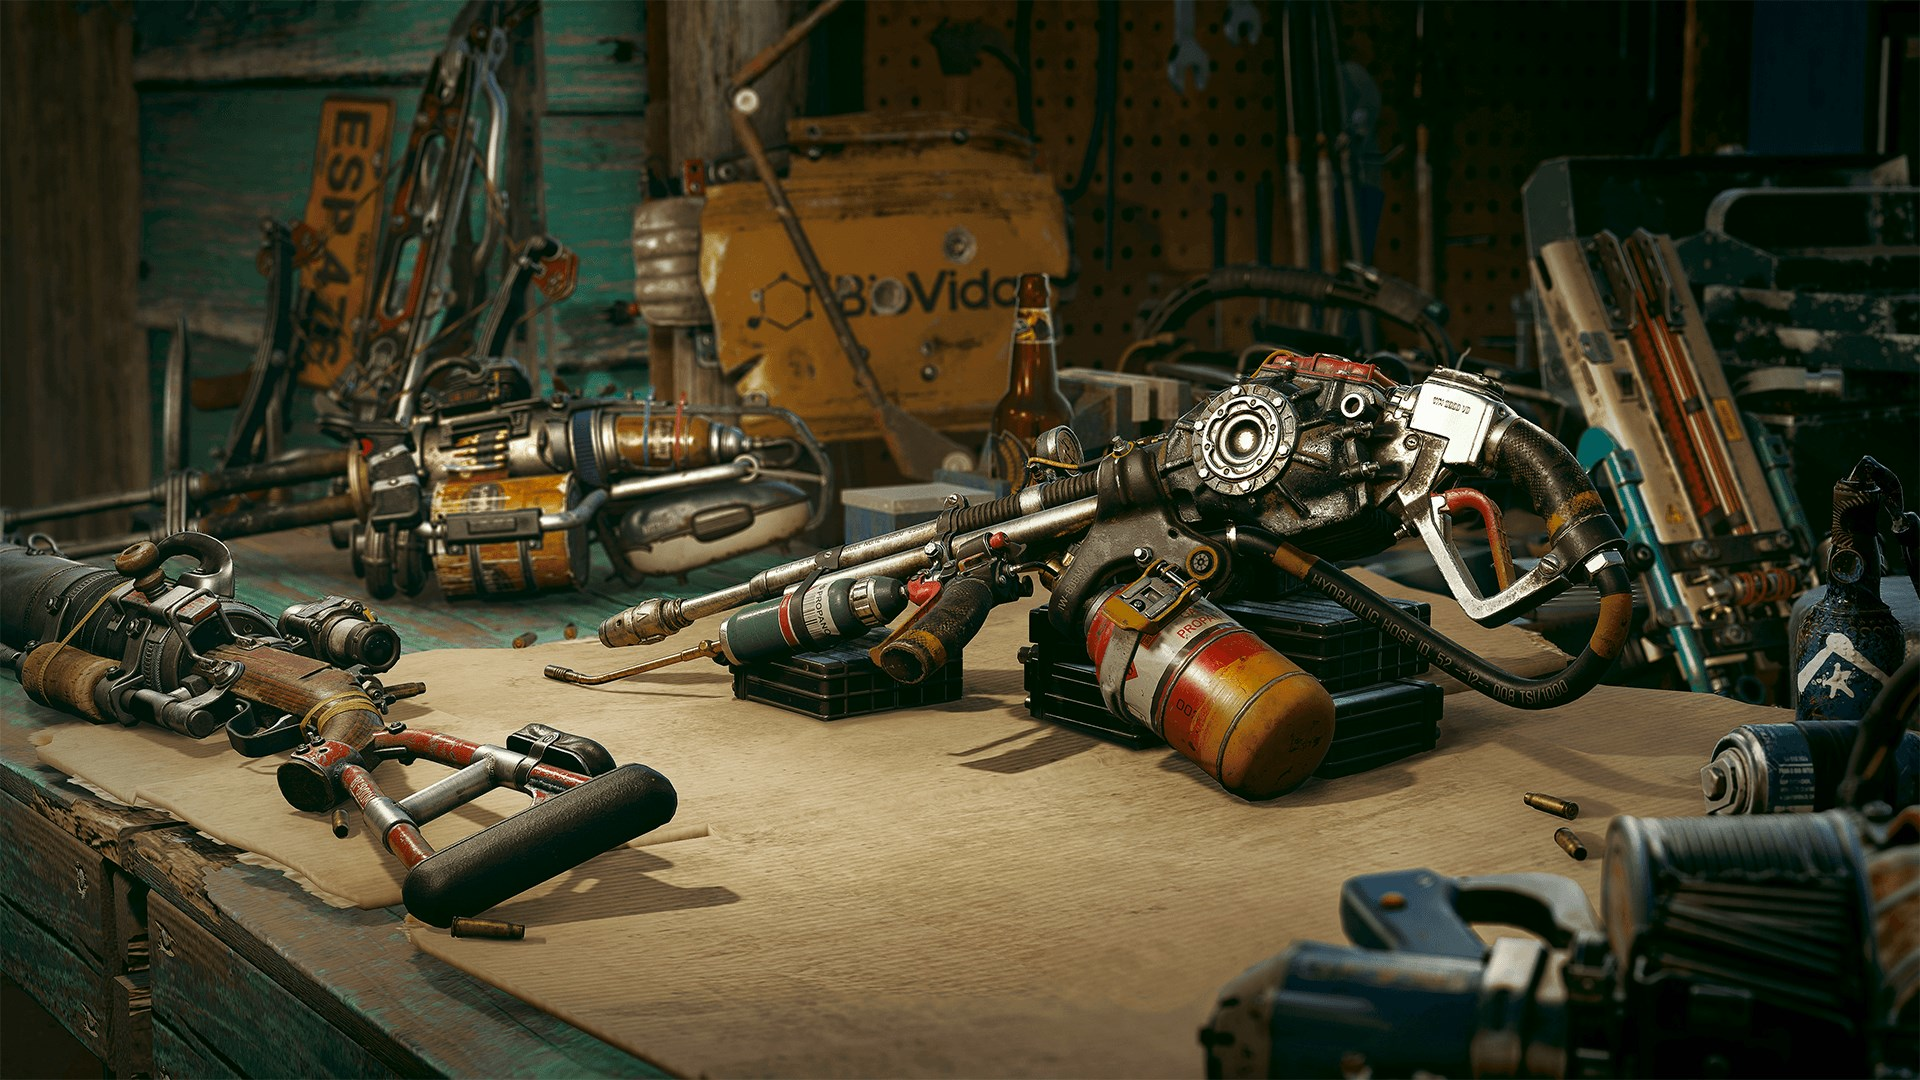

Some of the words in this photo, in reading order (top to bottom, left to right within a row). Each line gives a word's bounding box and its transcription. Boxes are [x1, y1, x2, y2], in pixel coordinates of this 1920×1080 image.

[815, 590, 832, 636] PROPANO
[1311, 573, 1380, 624] HYDRAULIC
[1381, 617, 1416, 647] HOSE
[1436, 652, 1452, 670] 52
